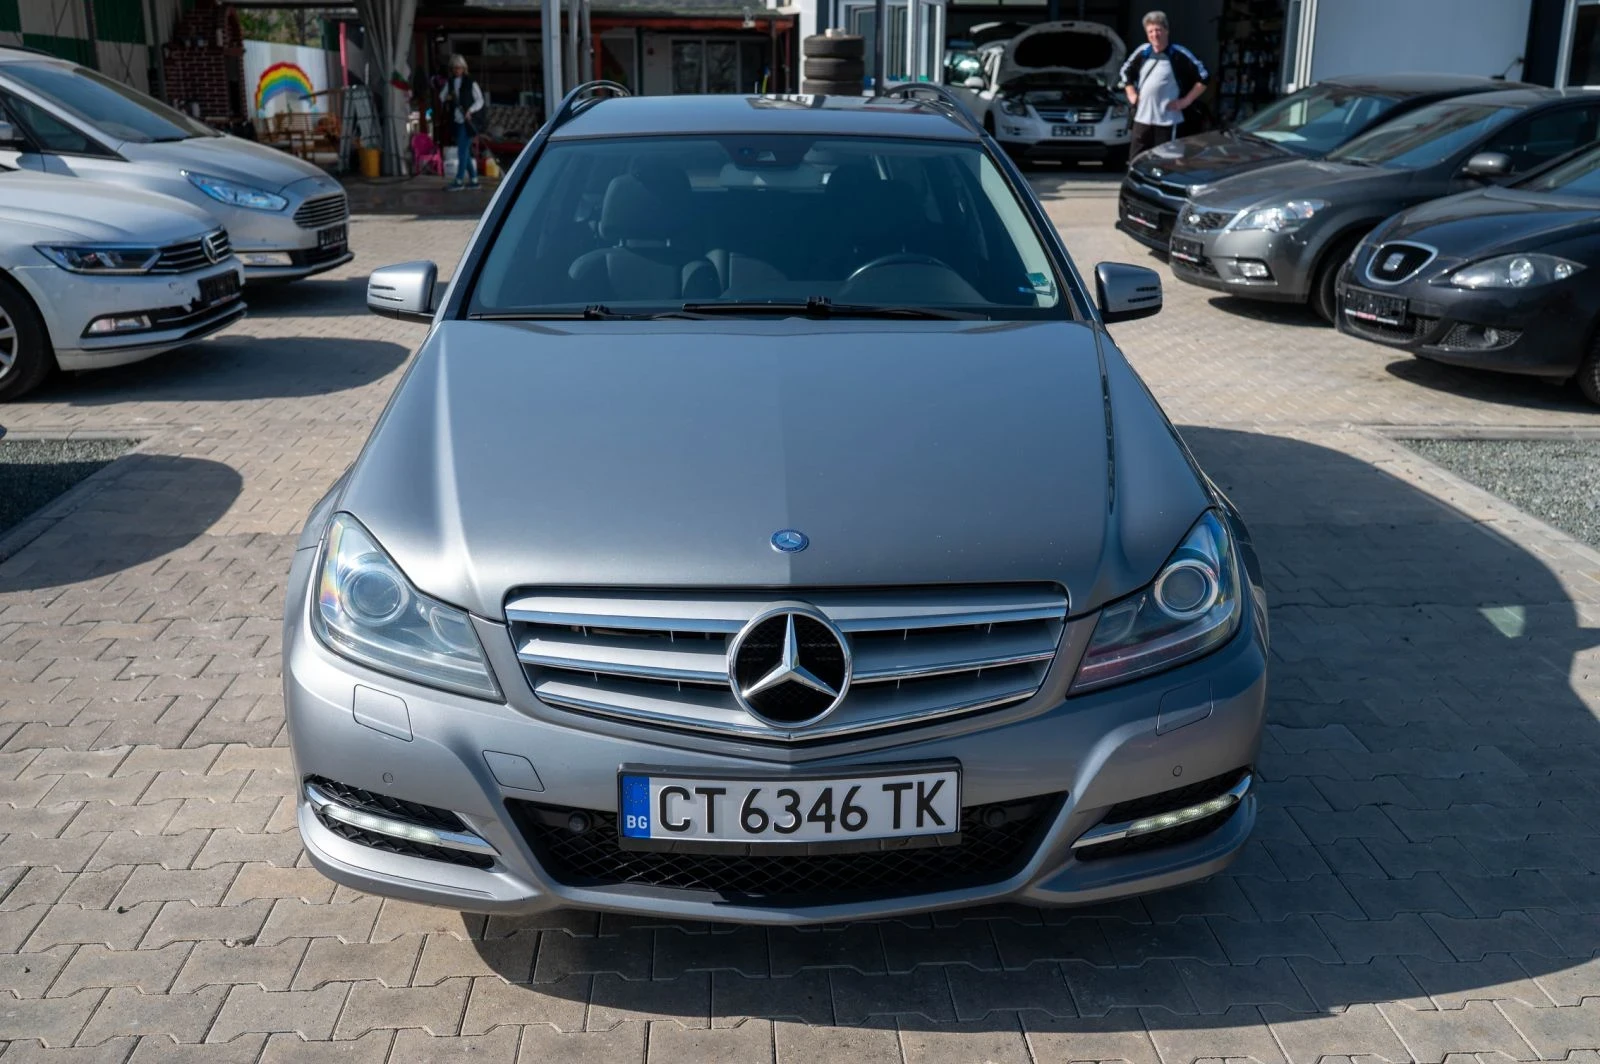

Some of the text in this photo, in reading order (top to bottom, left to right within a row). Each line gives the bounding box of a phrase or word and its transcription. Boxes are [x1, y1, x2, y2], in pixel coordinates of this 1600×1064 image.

[626, 815, 648, 829] BG
[659, 779, 946, 835] CT 6346 TK
